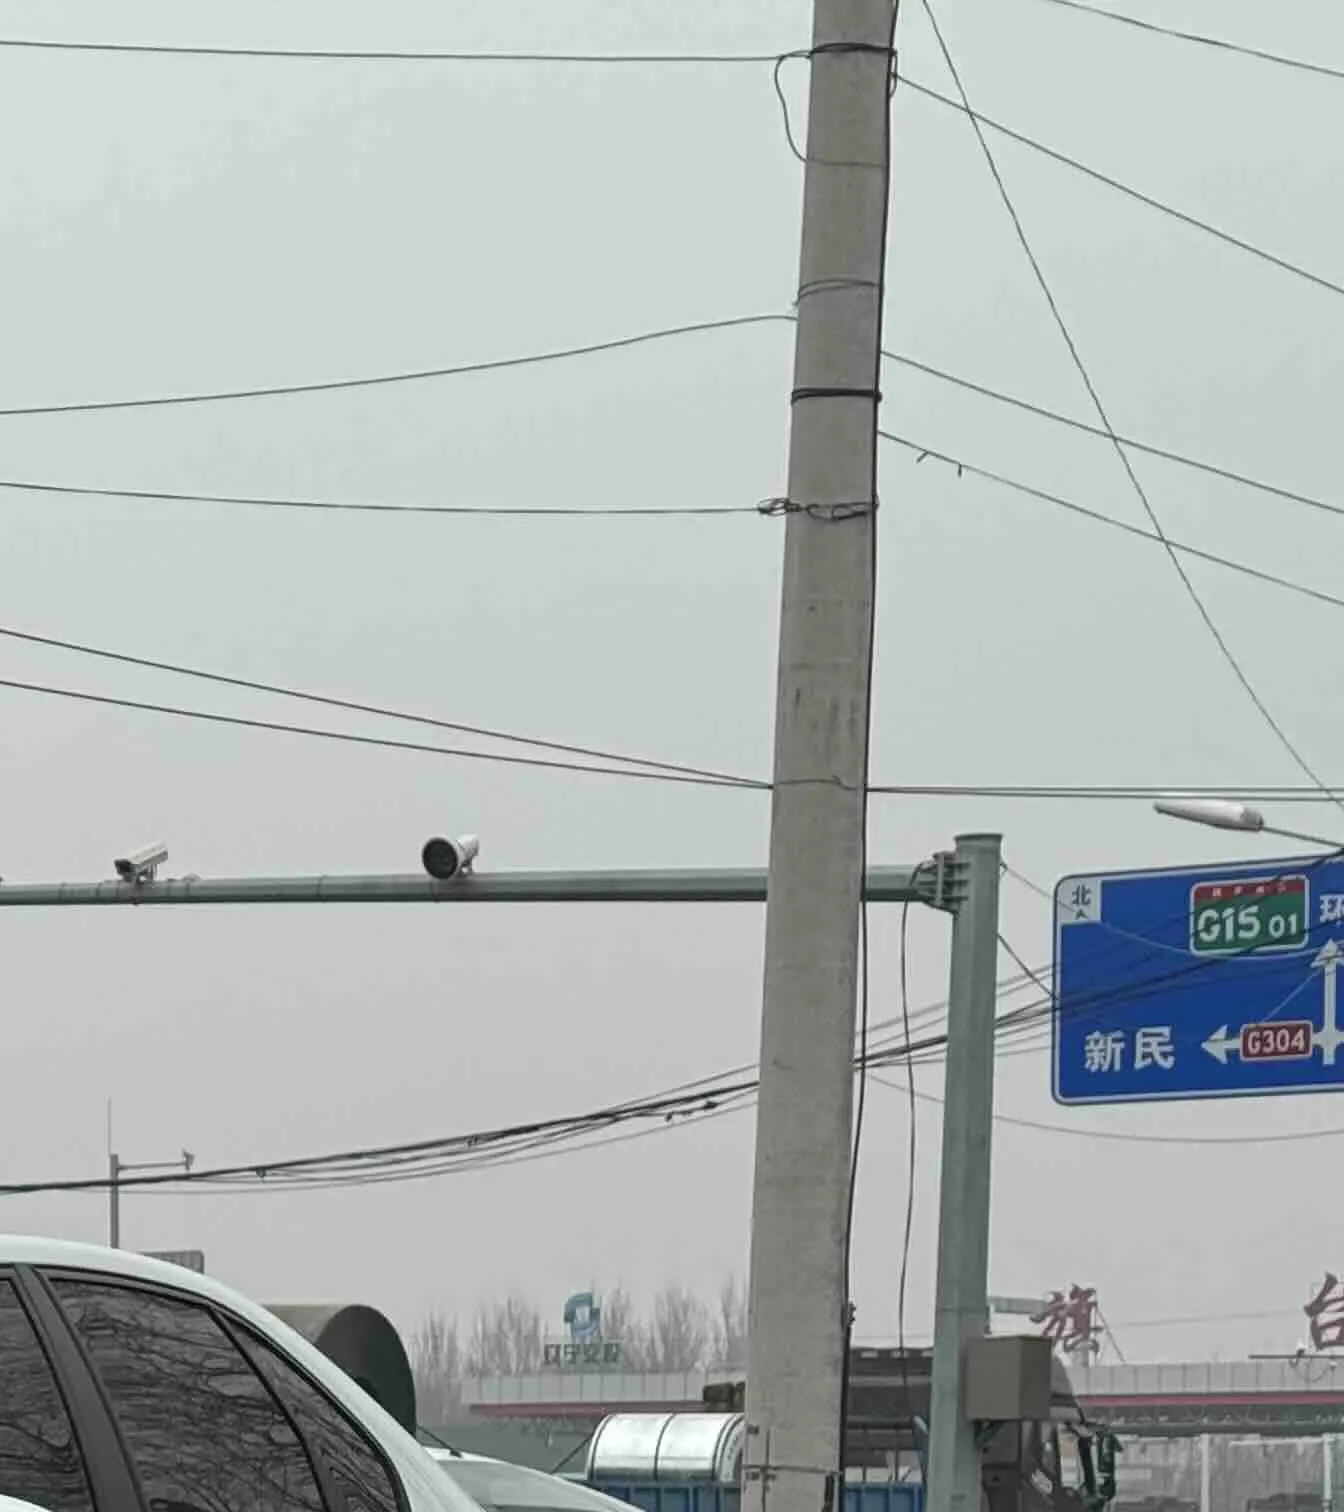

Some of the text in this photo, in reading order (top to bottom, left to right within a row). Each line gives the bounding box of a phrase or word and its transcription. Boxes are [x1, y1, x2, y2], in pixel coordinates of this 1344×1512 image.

[1072, 884, 1090, 906] 北
[1084, 1025, 1176, 1073] 新民
[1247, 1029, 1305, 1054] G304
